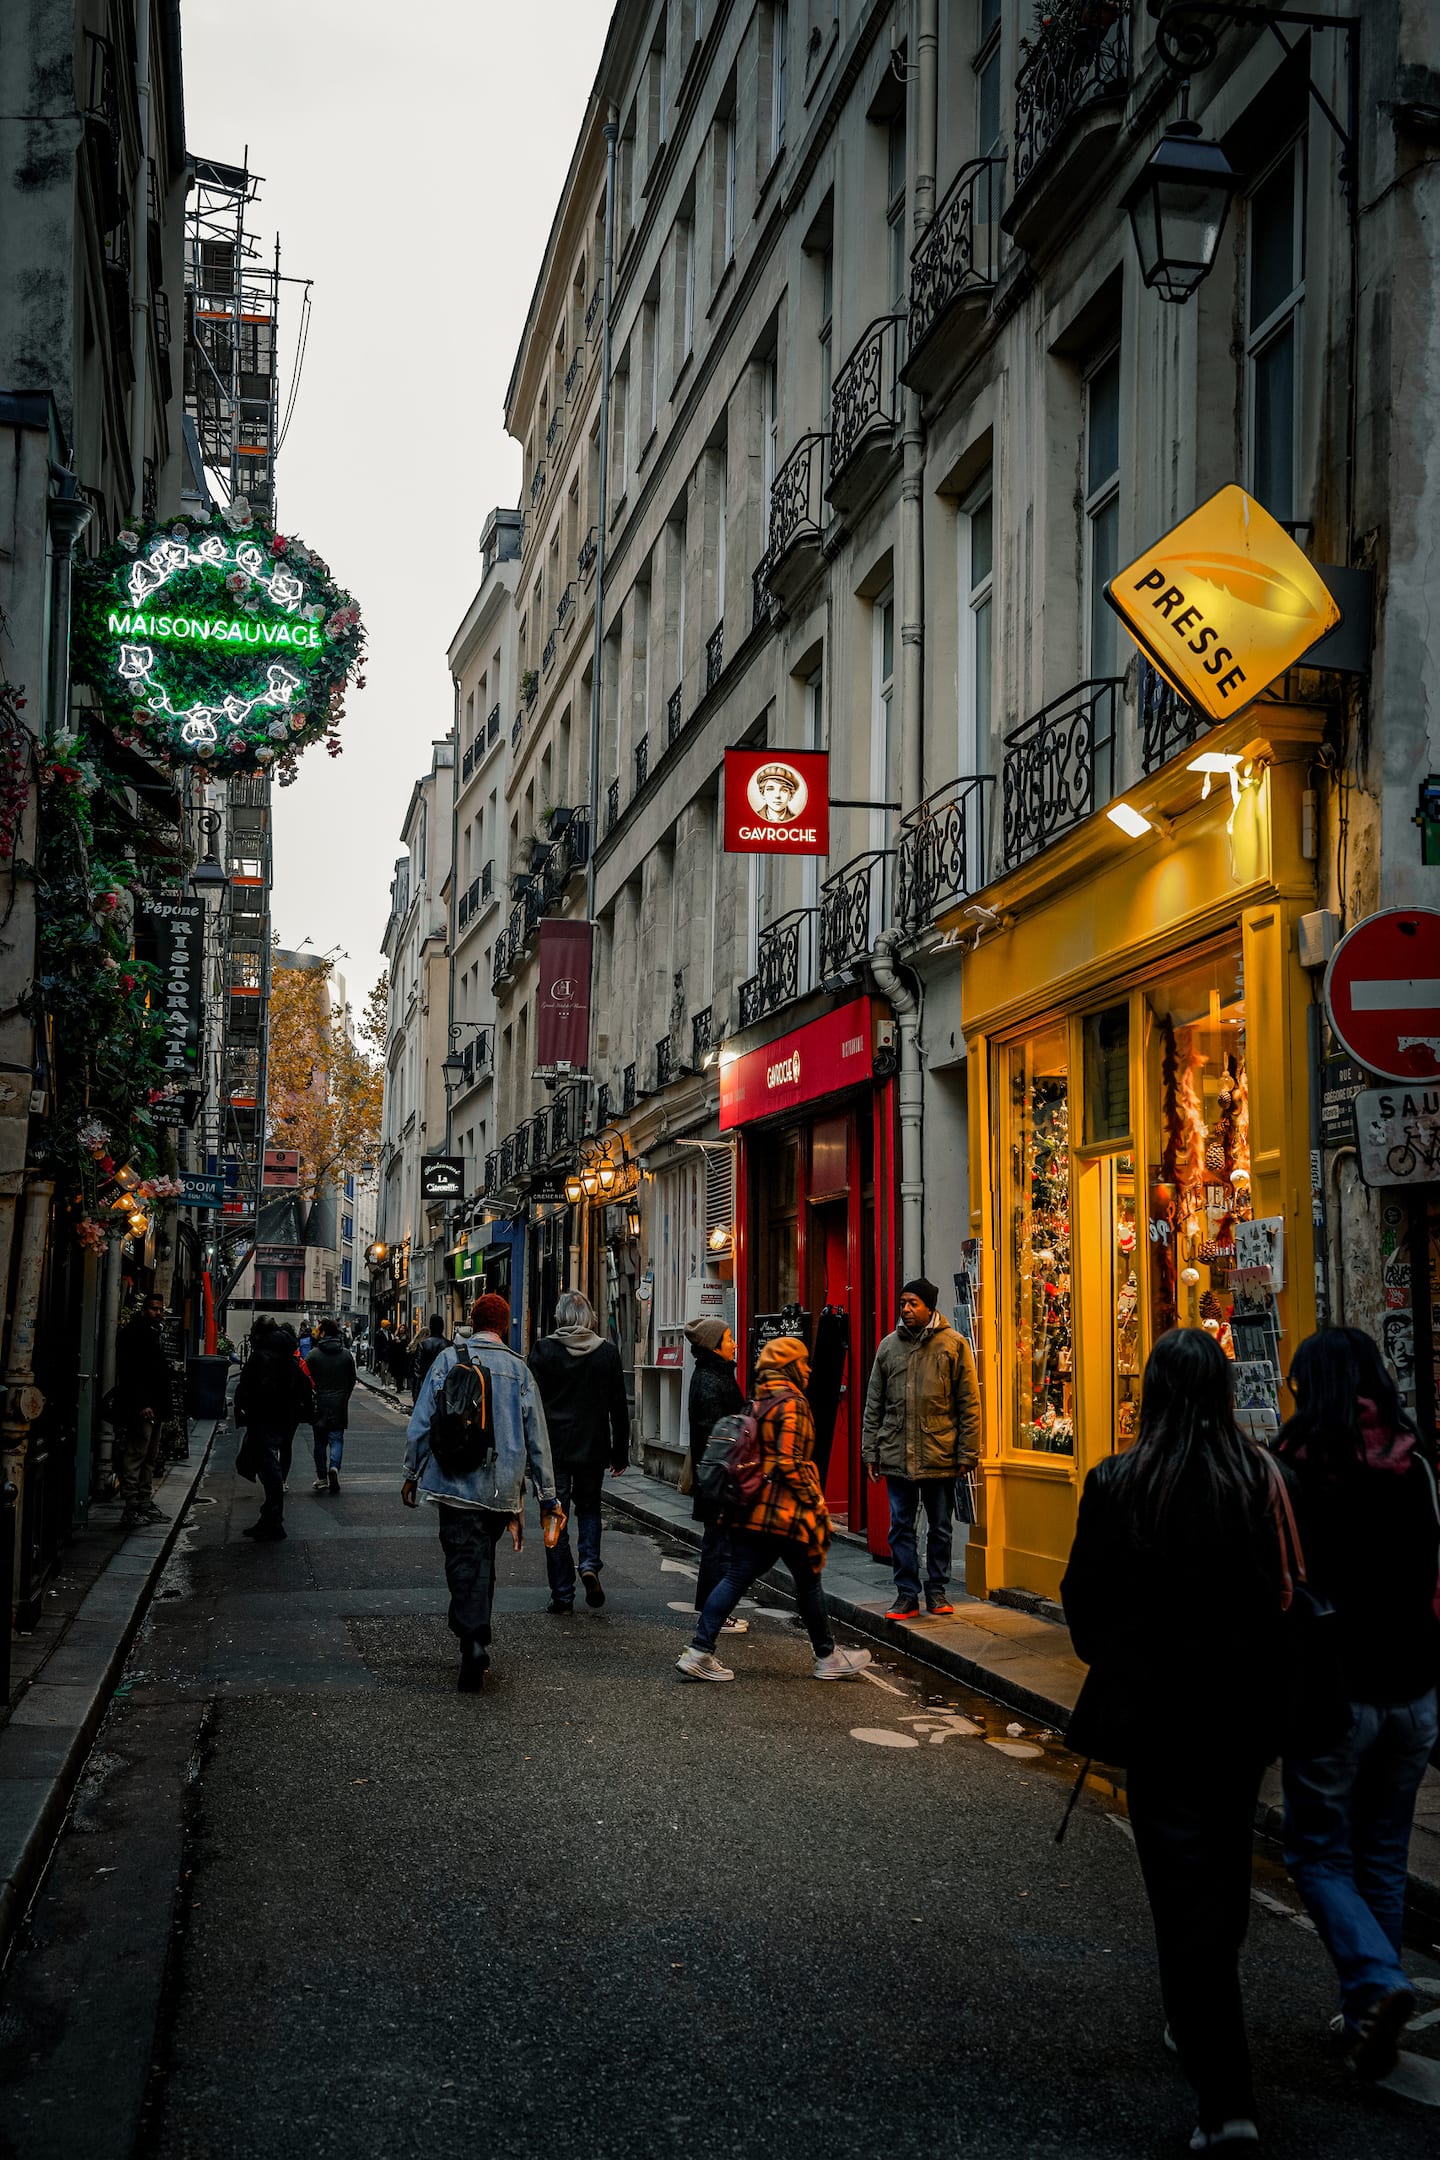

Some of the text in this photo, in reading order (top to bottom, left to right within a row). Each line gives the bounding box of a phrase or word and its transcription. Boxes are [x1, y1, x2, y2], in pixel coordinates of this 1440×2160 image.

[1133, 568, 1247, 698] PRESSE
[738, 826, 817, 843] GAVROCHE
[165, 921, 193, 1069] RISTORANTE
[766, 1057, 793, 1089] GAVROCHE
[1339, 1068, 1352, 1082] RUE
[182, 1180, 216, 1194] OOM
[437, 1174, 448, 1183] La
